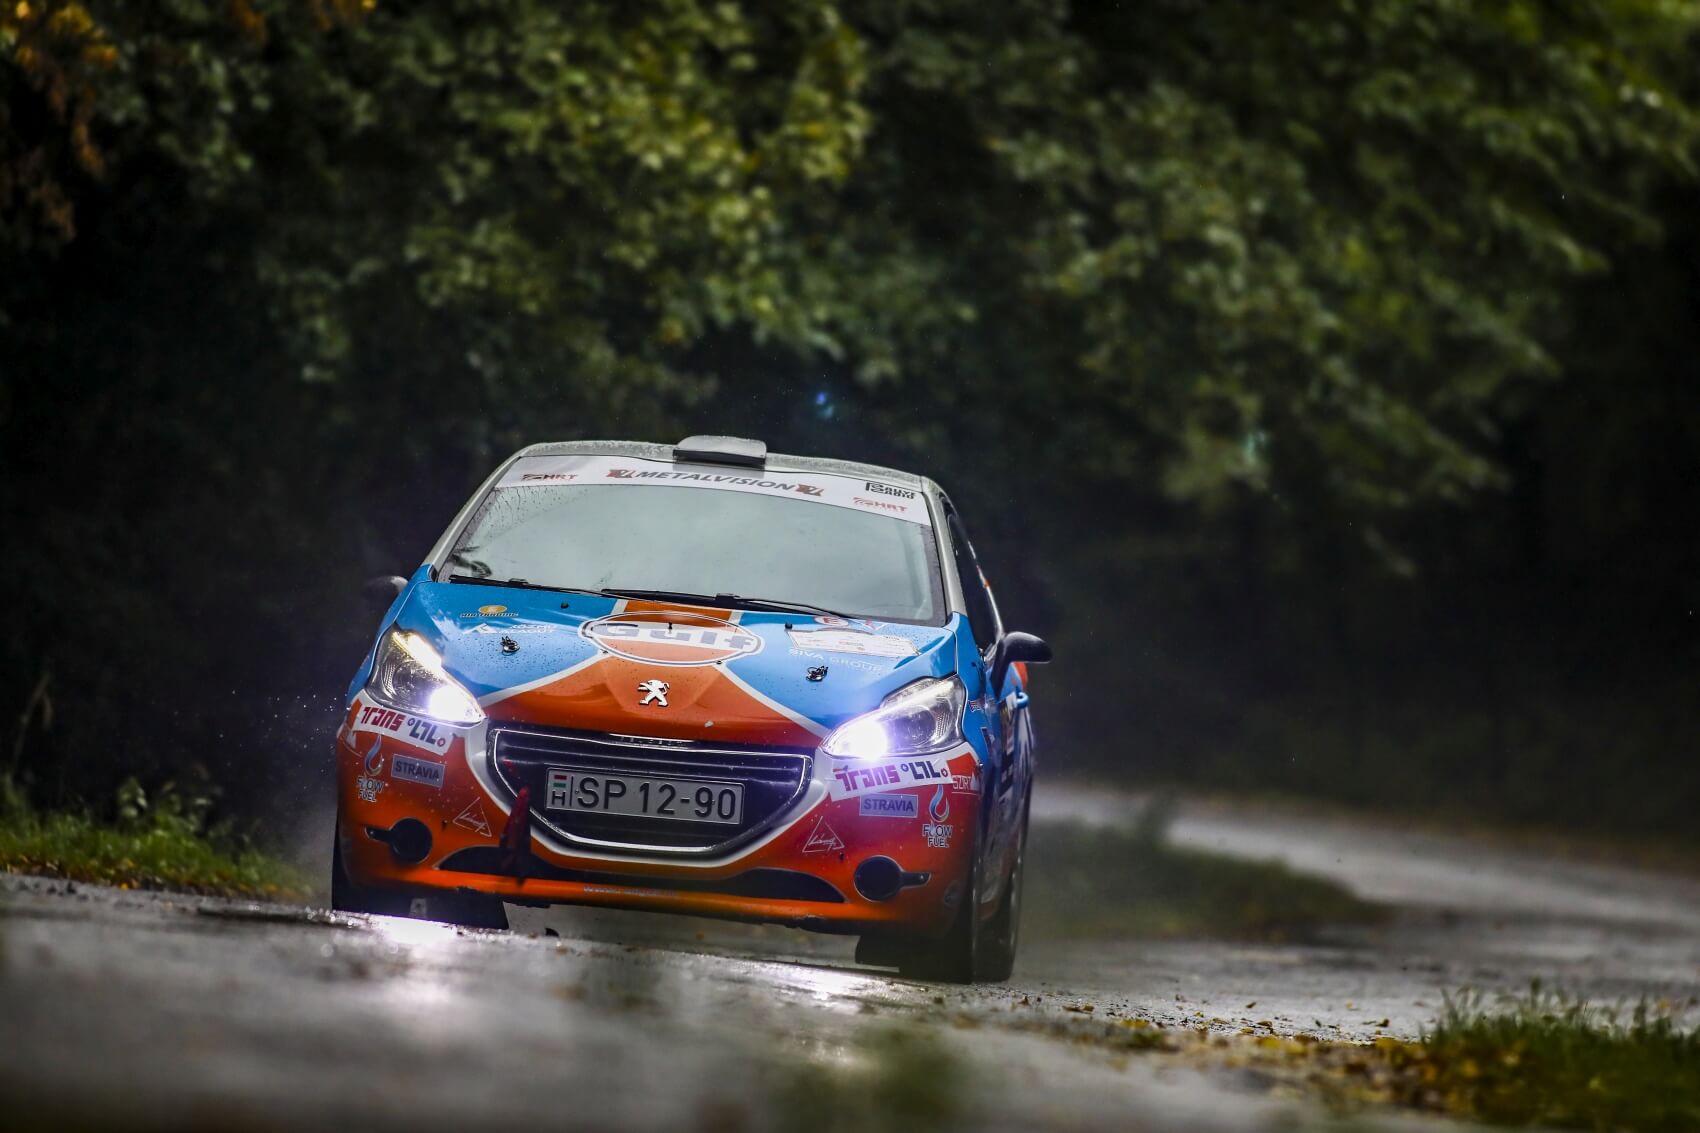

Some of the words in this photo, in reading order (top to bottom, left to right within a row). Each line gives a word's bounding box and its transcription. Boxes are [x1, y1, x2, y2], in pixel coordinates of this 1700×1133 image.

[634, 470, 796, 491] METALVISION
[394, 760, 440, 781] STRAVIA
[357, 789, 377, 803] FUEL
[551, 790, 566, 807] H
[576, 776, 627, 810] SP
[638, 782, 737, 820] 12-90
[862, 799, 915, 813] STRAVIA
[927, 836, 949, 848] FUEL
